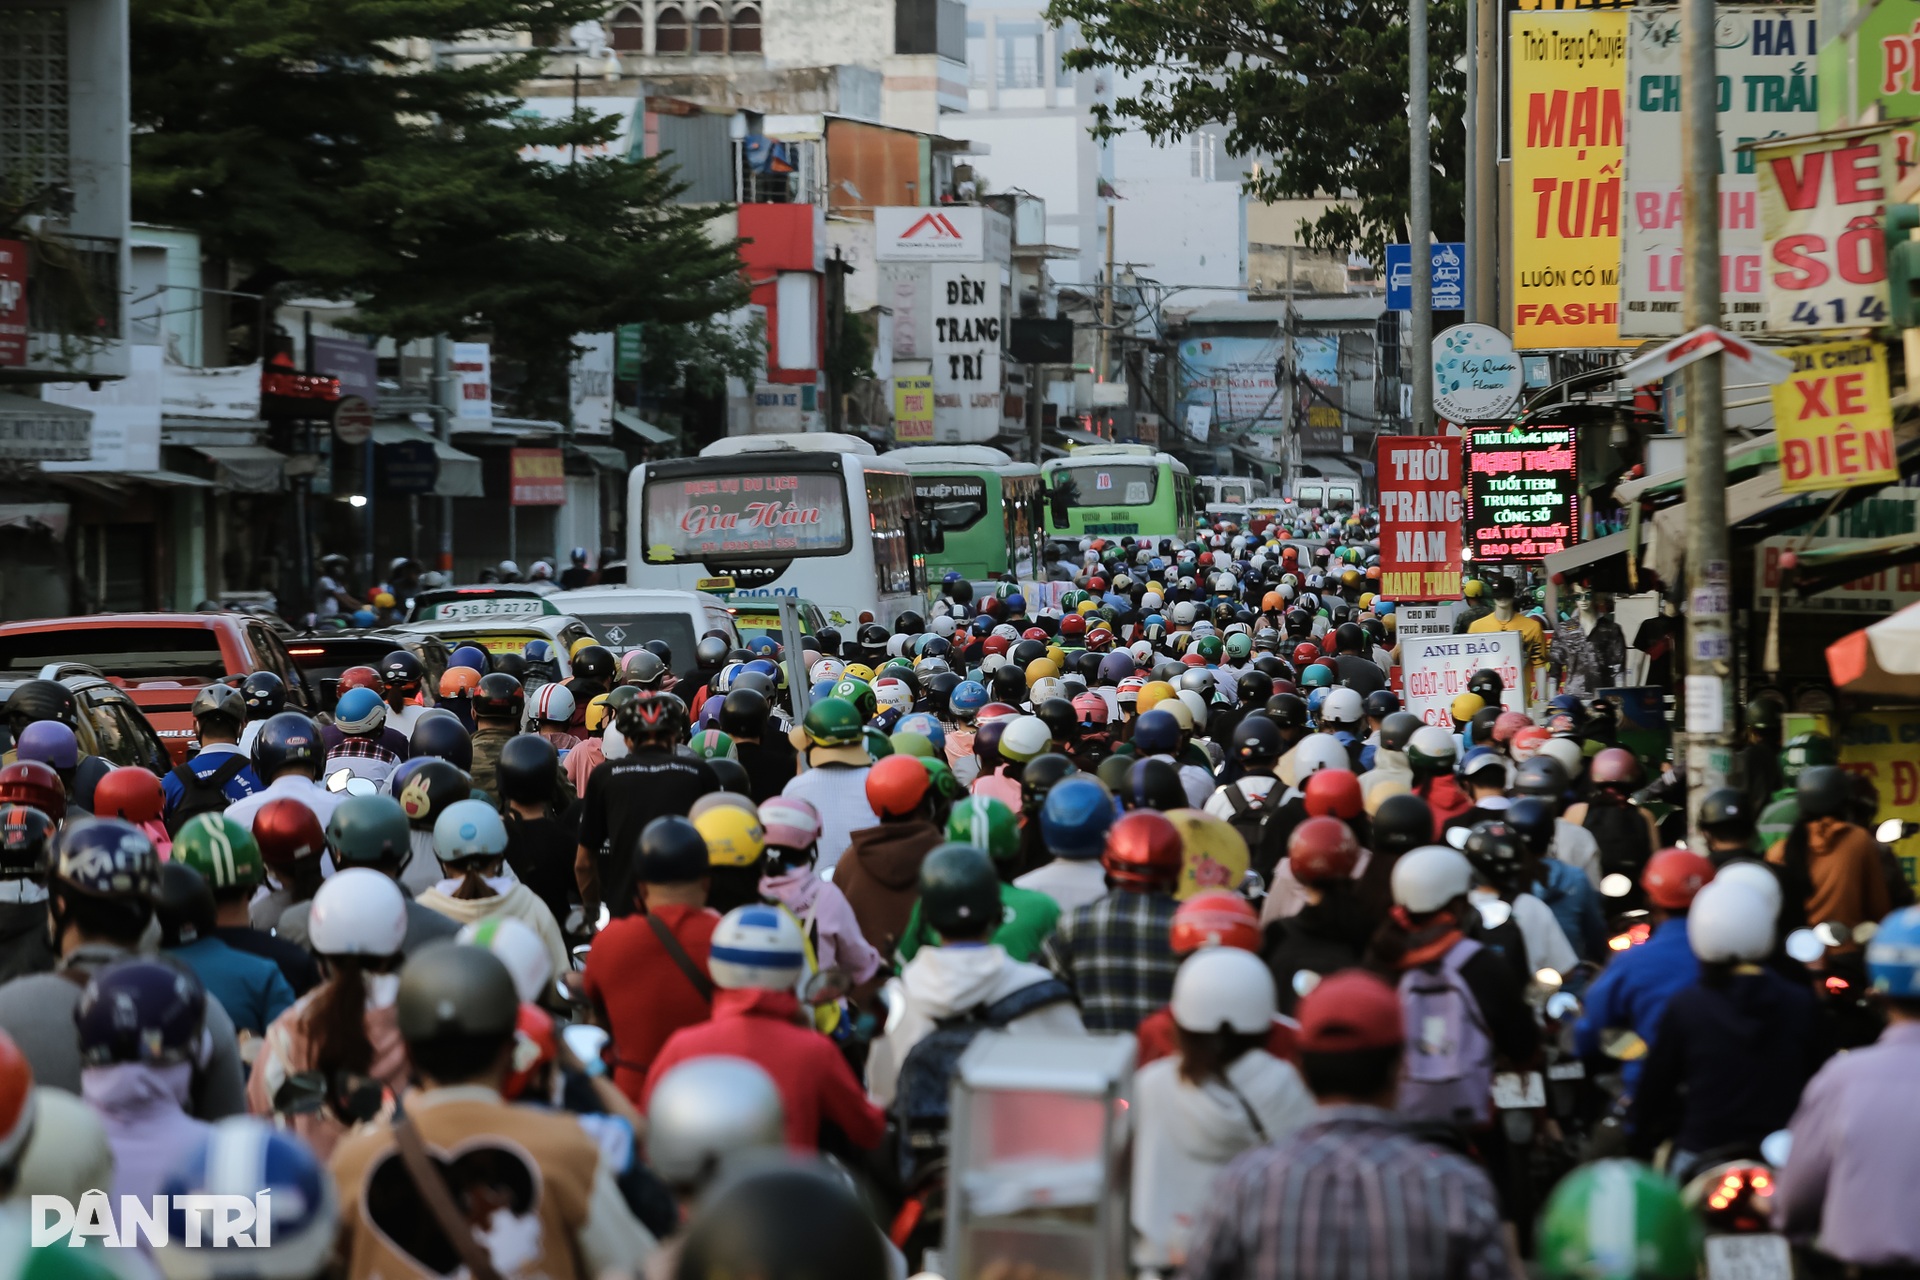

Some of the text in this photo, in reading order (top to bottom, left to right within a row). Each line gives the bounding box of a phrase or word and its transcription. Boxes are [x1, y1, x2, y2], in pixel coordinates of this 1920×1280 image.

[1752, 12, 1796, 56] HÀ
[1522, 28, 1626, 68] Thời Trang Chuyê
[1639, 75, 1732, 112] CHO
[1771, 137, 1885, 211] VÉ
[1635, 184, 1756, 230] BÁH
[1521, 266, 1566, 287] LUÔN
[1572, 265, 1596, 287] CÓ
[1648, 247, 1761, 293] LÒG
[947, 273, 986, 305] ĐÈN
[936, 317, 1001, 343] TRANG
[948, 348, 985, 381] TRÍ
[1482, 358, 1517, 375] Quan
[1794, 372, 1868, 421] XE
[1473, 430, 1502, 445] THỜI
[1542, 432, 1569, 444] NAM
[1391, 441, 1449, 481] THỜI
[1781, 421, 1897, 482] ĐIỆN
[684, 479, 717, 497] DỊCH
[744, 477, 763, 492] DU
[766, 475, 799, 493] LỊCH
[952, 483, 983, 496] THÀNH
[1099, 475, 1109, 488] 10
[1522, 478, 1557, 490] TEEN
[1381, 490, 1462, 523] TRANG
[1481, 491, 1564, 507] TRUNG NIÊN
[680, 500, 823, 535] Gia Hân
[1493, 508, 1530, 523] CÔNG
[775, 537, 798, 548] 555
[1476, 522, 1570, 540] GIÁ TỐT NHẤT
[1396, 531, 1447, 563] NAM
[1480, 543, 1510, 555] BAO
[1382, 563, 1461, 601] MẠNH TUẤN
[463, 602, 539, 615] 38.27 27 27
[1407, 610, 1423, 620] CHO
[1422, 637, 1502, 658] ANH BẢO
